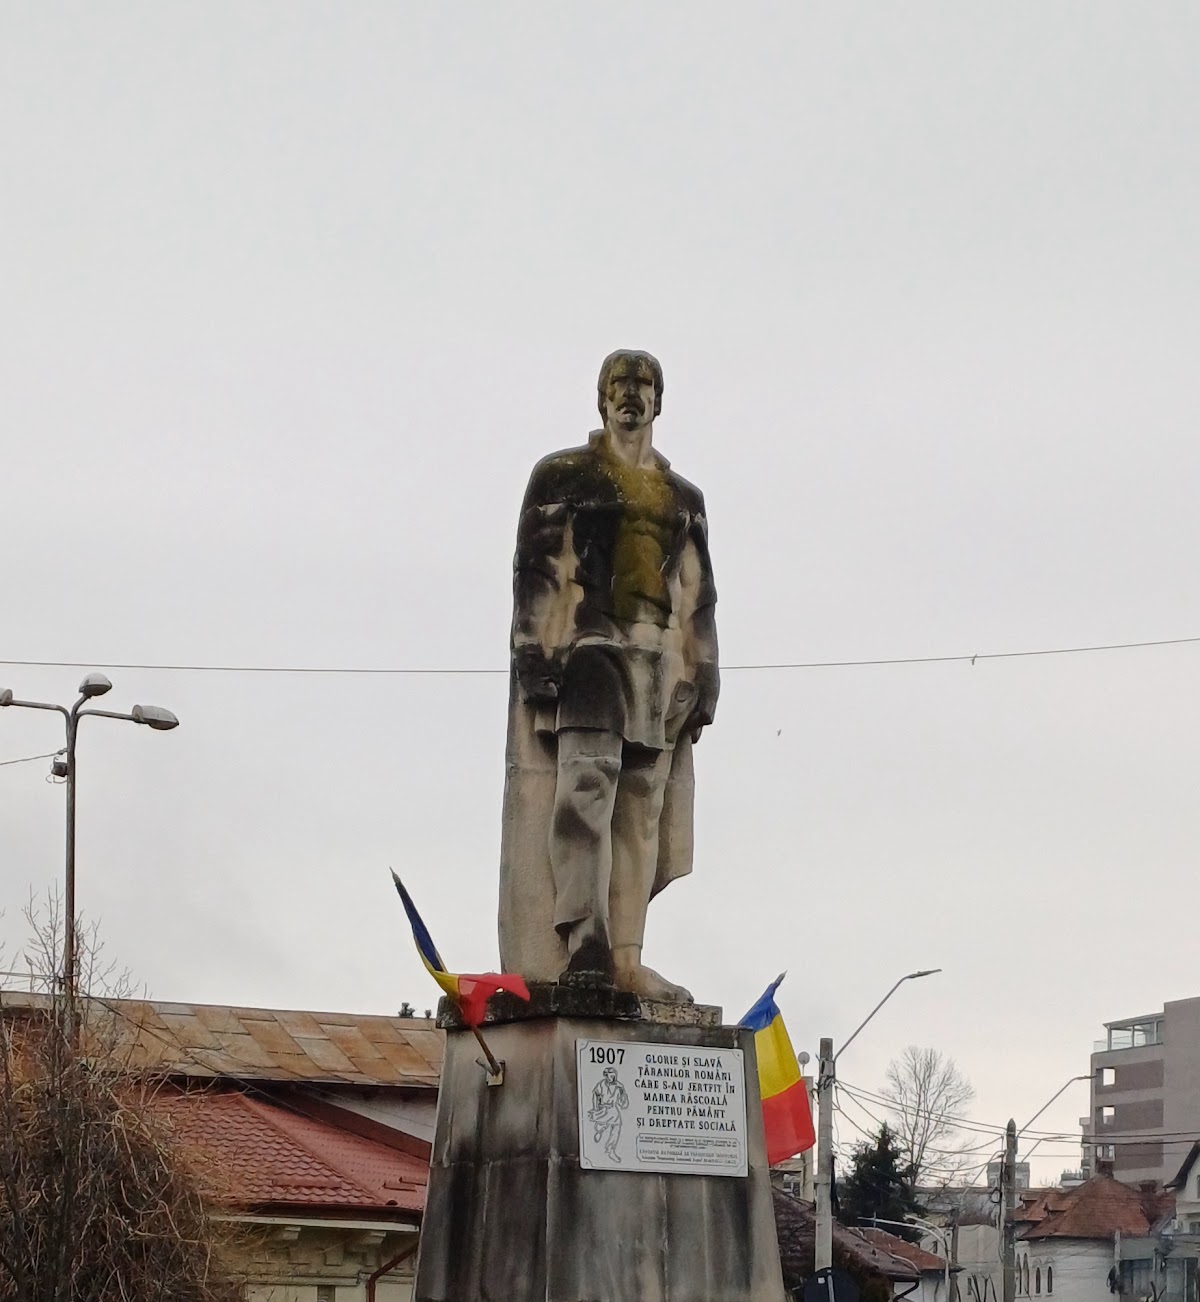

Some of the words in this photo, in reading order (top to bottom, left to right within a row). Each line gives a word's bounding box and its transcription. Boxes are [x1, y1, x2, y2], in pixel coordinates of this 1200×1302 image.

[589, 1046, 625, 1065] 1907
[645, 1054, 679, 1066] GLORIE
[681, 1056, 690, 1067] ȘI
[693, 1056, 723, 1068] SLAVĂ
[638, 1064, 690, 1079] ȚĂRANILOR
[694, 1069, 732, 1082] ROMÂNI
[634, 1078, 659, 1089] CARE
[662, 1080, 684, 1091] S-AU
[687, 1082, 722, 1093] JERTFIT
[725, 1082, 736, 1094] ÎN
[643, 1092, 677, 1103] MAREA
[680, 1093, 728, 1106] RĂSCOALĂ
[647, 1105, 683, 1116] PENTRU
[686, 1106, 726, 1119] PĂMÂNT
[636, 1117, 645, 1129] ȘI
[649, 1118, 696, 1129] DREPTATE
[698, 1120, 737, 1132] SOCIALĂ
